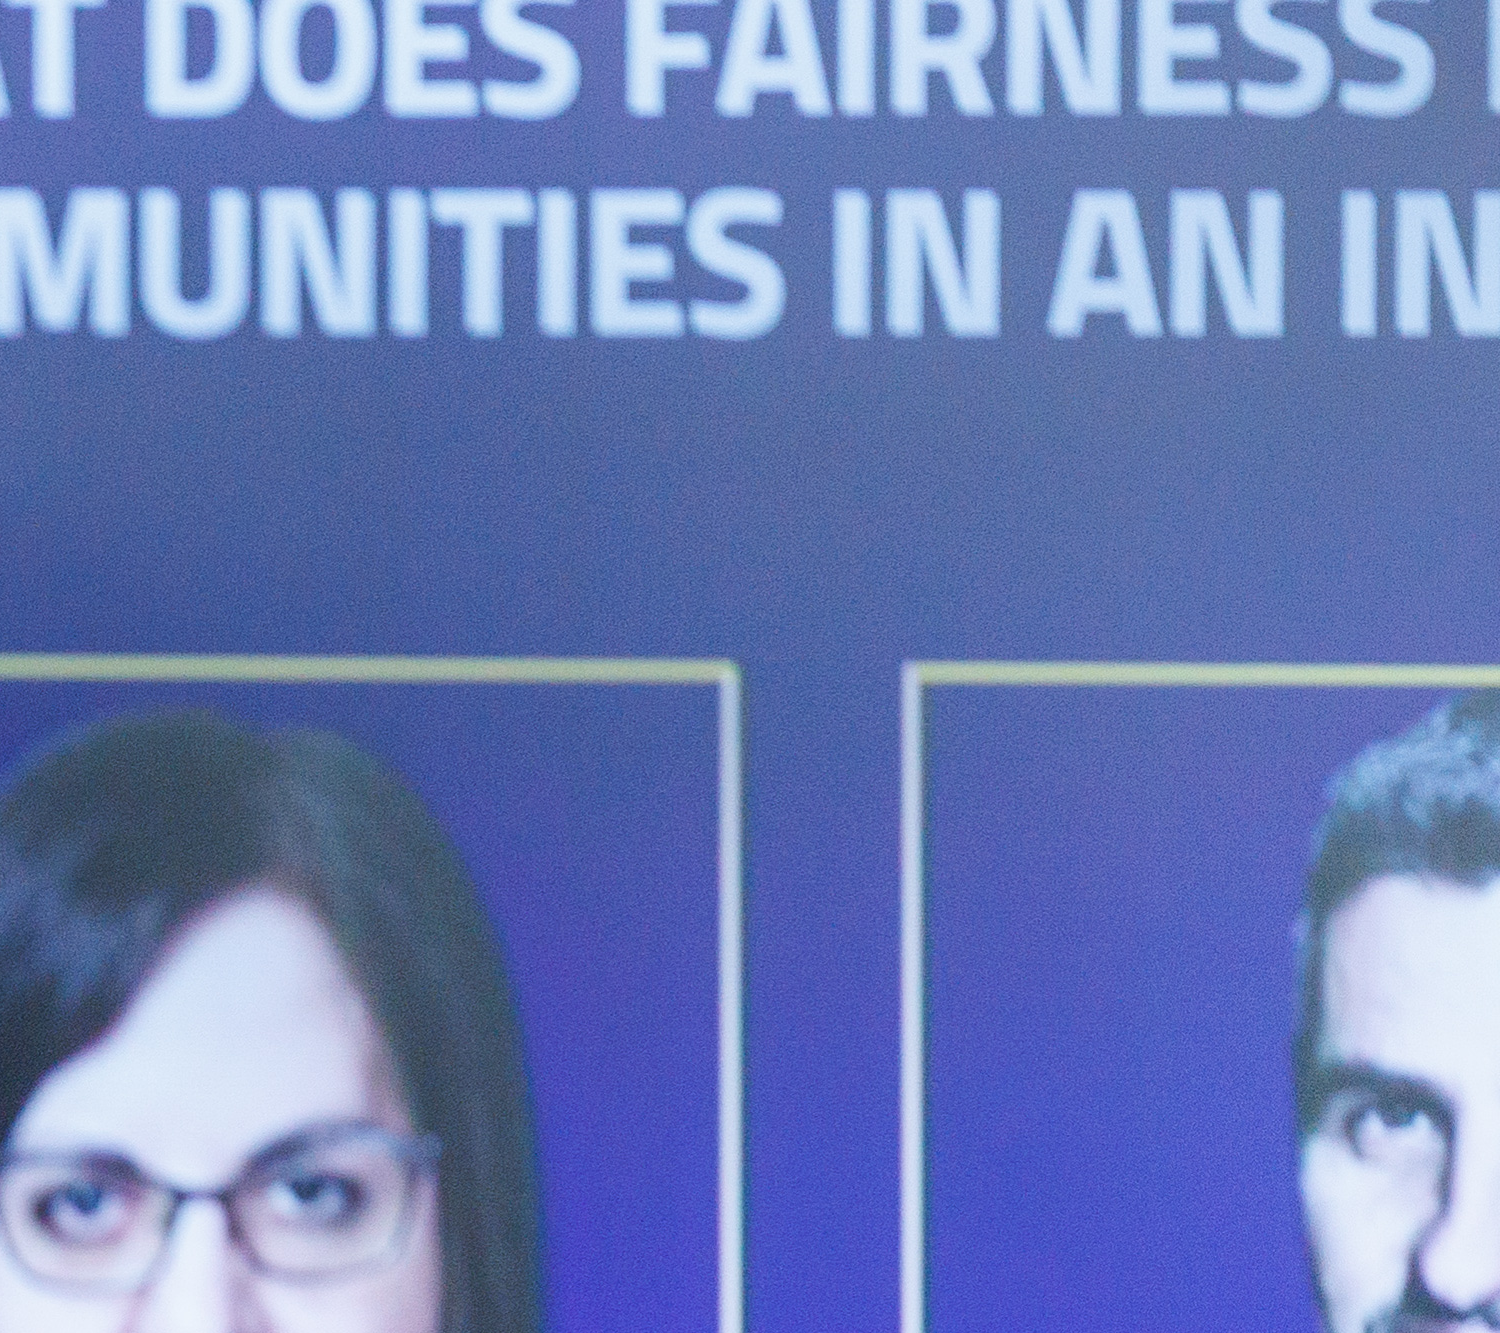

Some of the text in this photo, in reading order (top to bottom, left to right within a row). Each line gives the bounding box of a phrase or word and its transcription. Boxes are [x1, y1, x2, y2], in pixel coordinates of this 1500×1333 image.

[146, 0, 579, 119] DOES
[626, 0, 1433, 117] FAIRNESS
[834, 190, 1000, 336] IN
[1048, 190, 1283, 336] AN
[1342, 190, 1500, 337] IN
